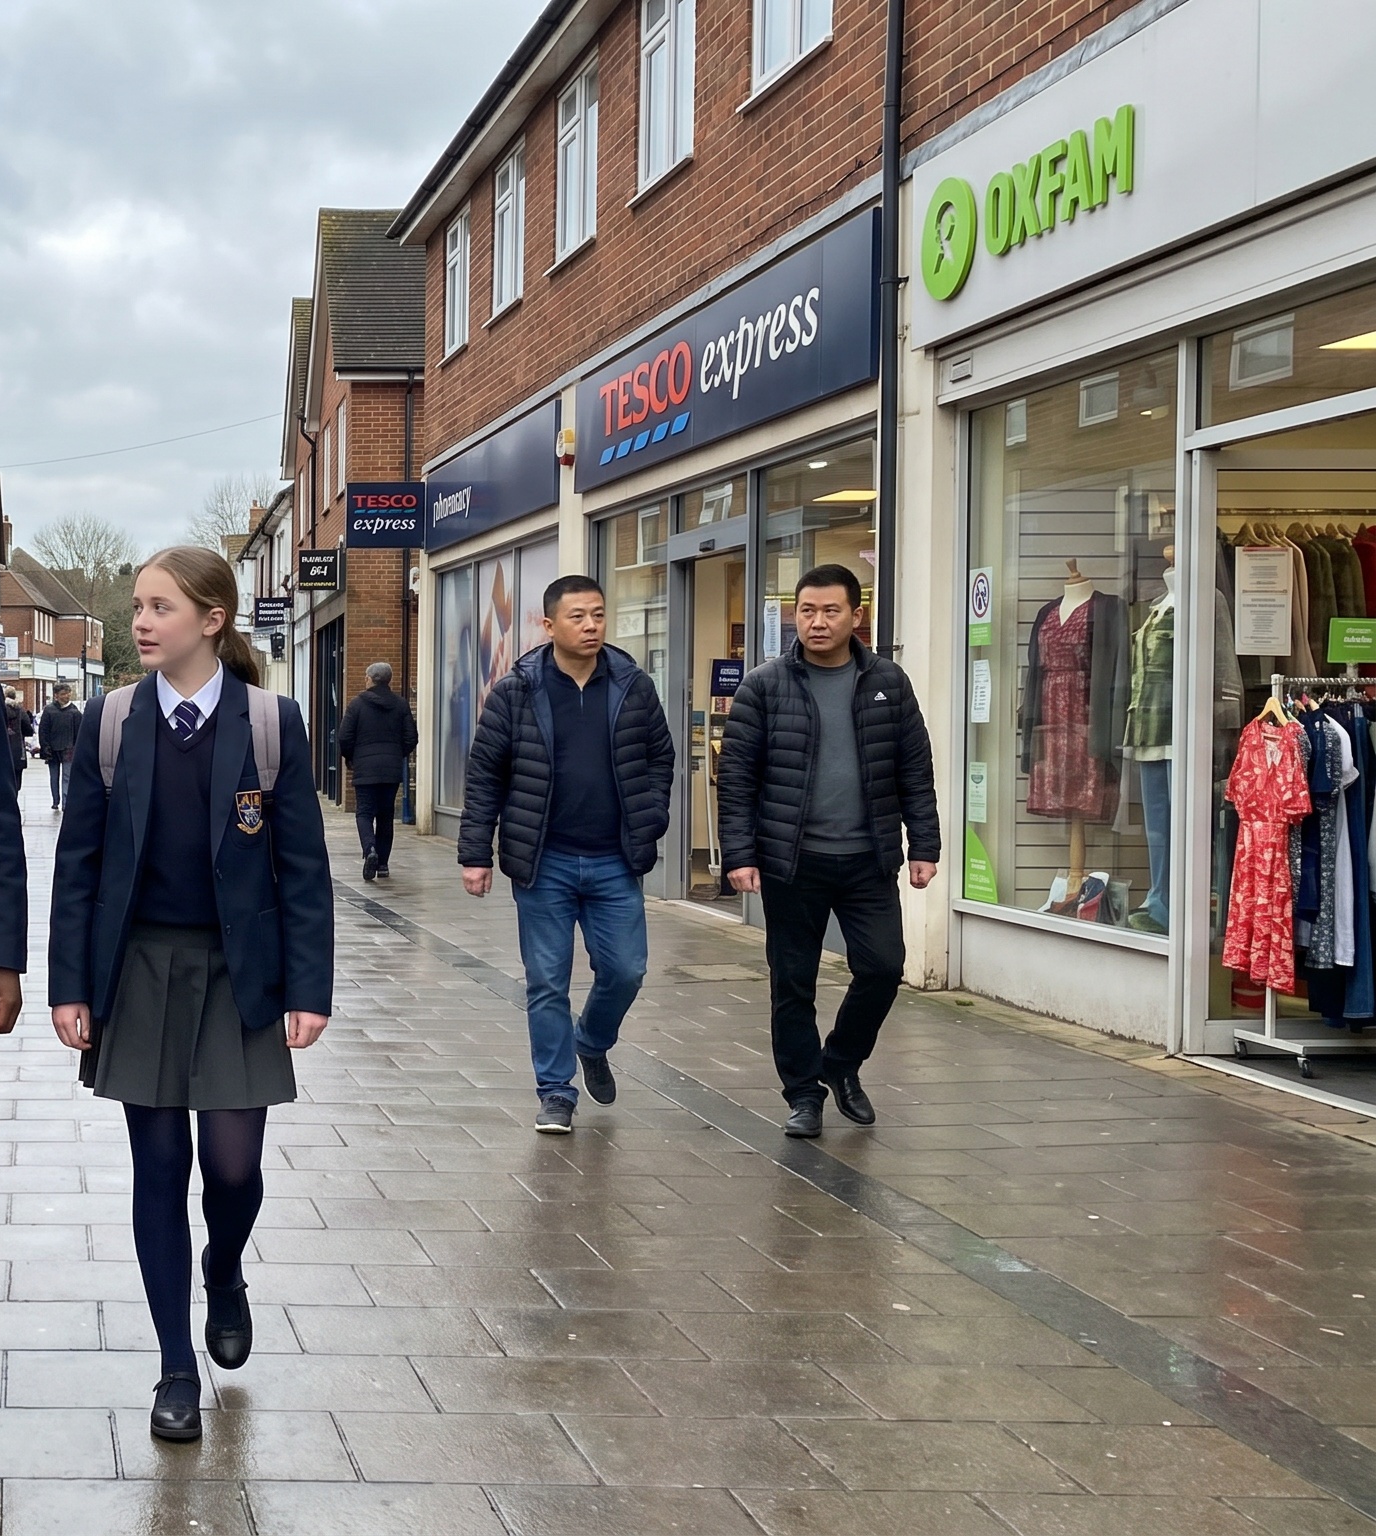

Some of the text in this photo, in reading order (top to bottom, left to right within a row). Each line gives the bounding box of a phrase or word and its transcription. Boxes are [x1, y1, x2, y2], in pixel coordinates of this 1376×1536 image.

[984, 104, 1135, 256] OXFAM
[599, 285, 820, 437] TESCO express
[352, 494, 417, 508] TESCO
[353, 517, 417, 534] express
